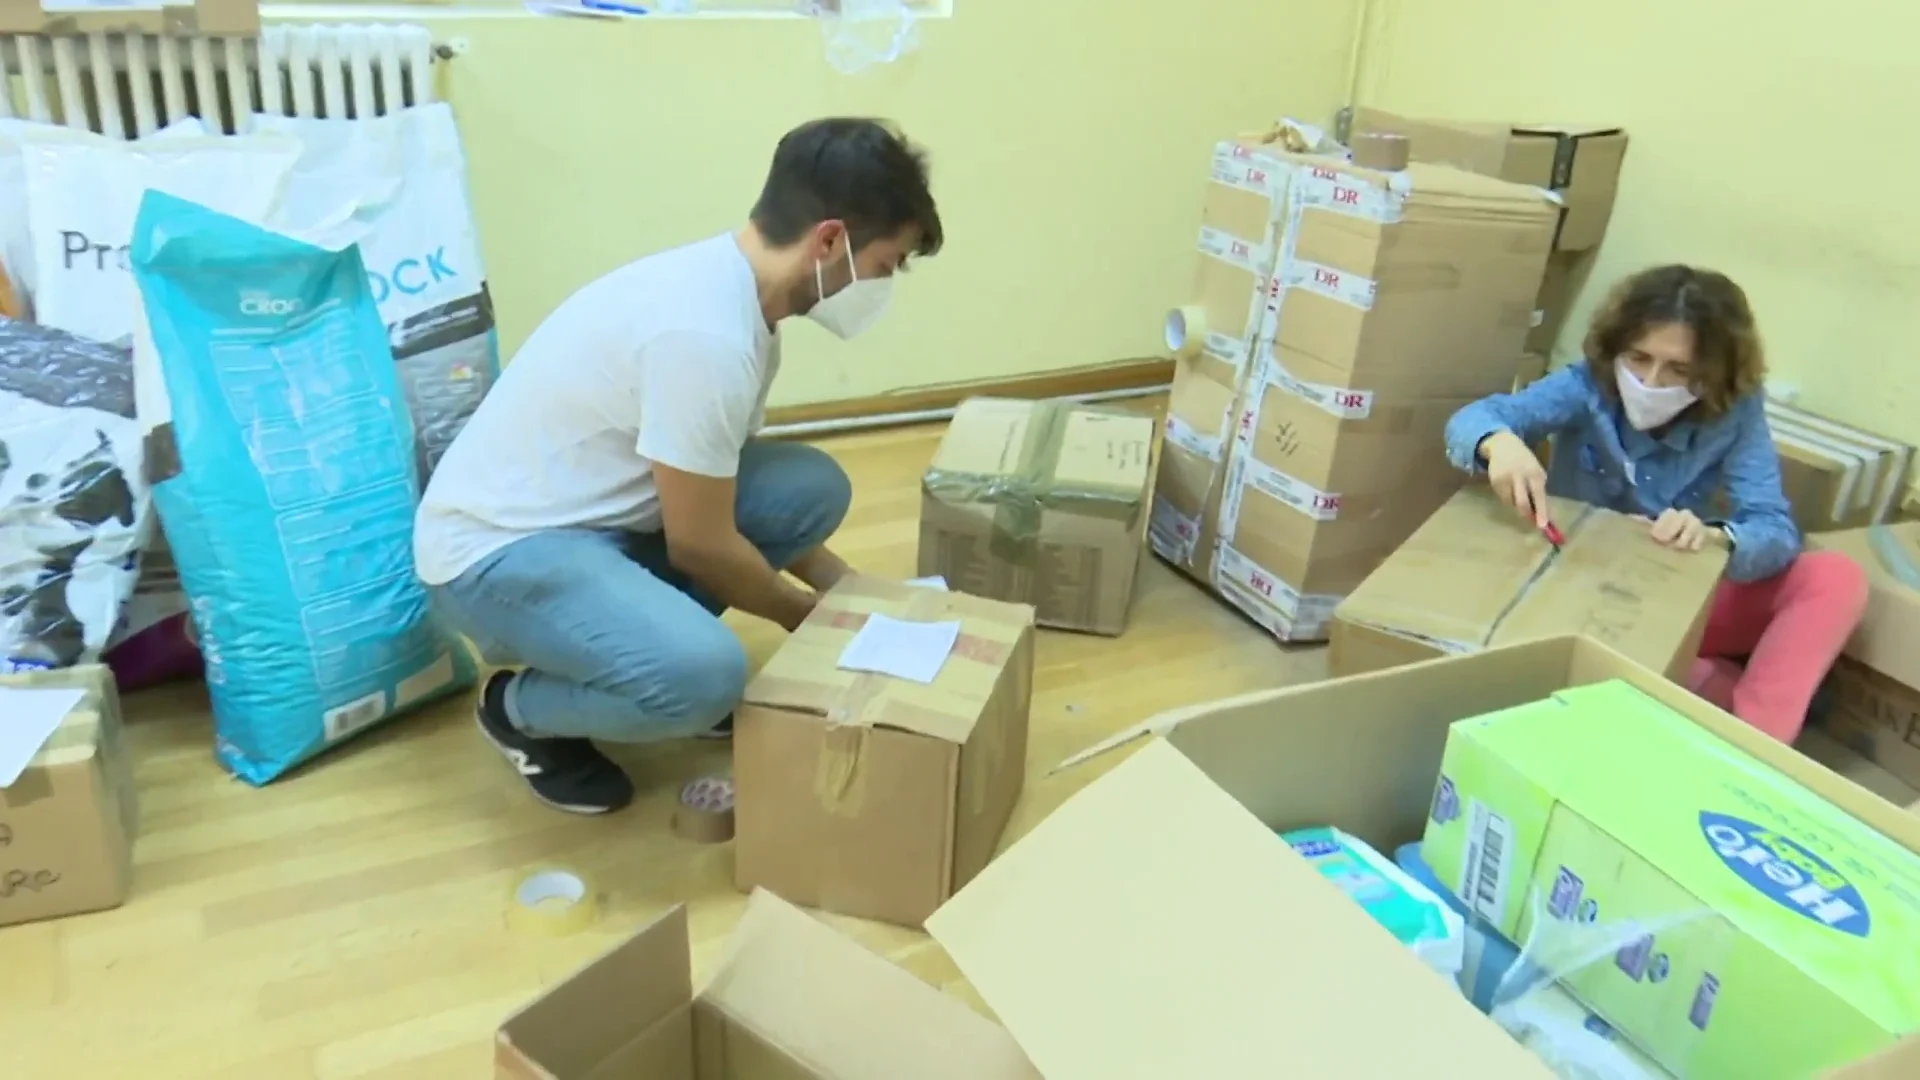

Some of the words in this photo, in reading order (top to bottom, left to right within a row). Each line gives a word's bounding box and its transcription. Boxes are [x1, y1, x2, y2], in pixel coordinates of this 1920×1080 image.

[1333, 186, 1358, 206] DR
[1314, 268, 1340, 288] DR
[1334, 391, 1365, 408] DR
[1705, 823, 1861, 925] Hero
